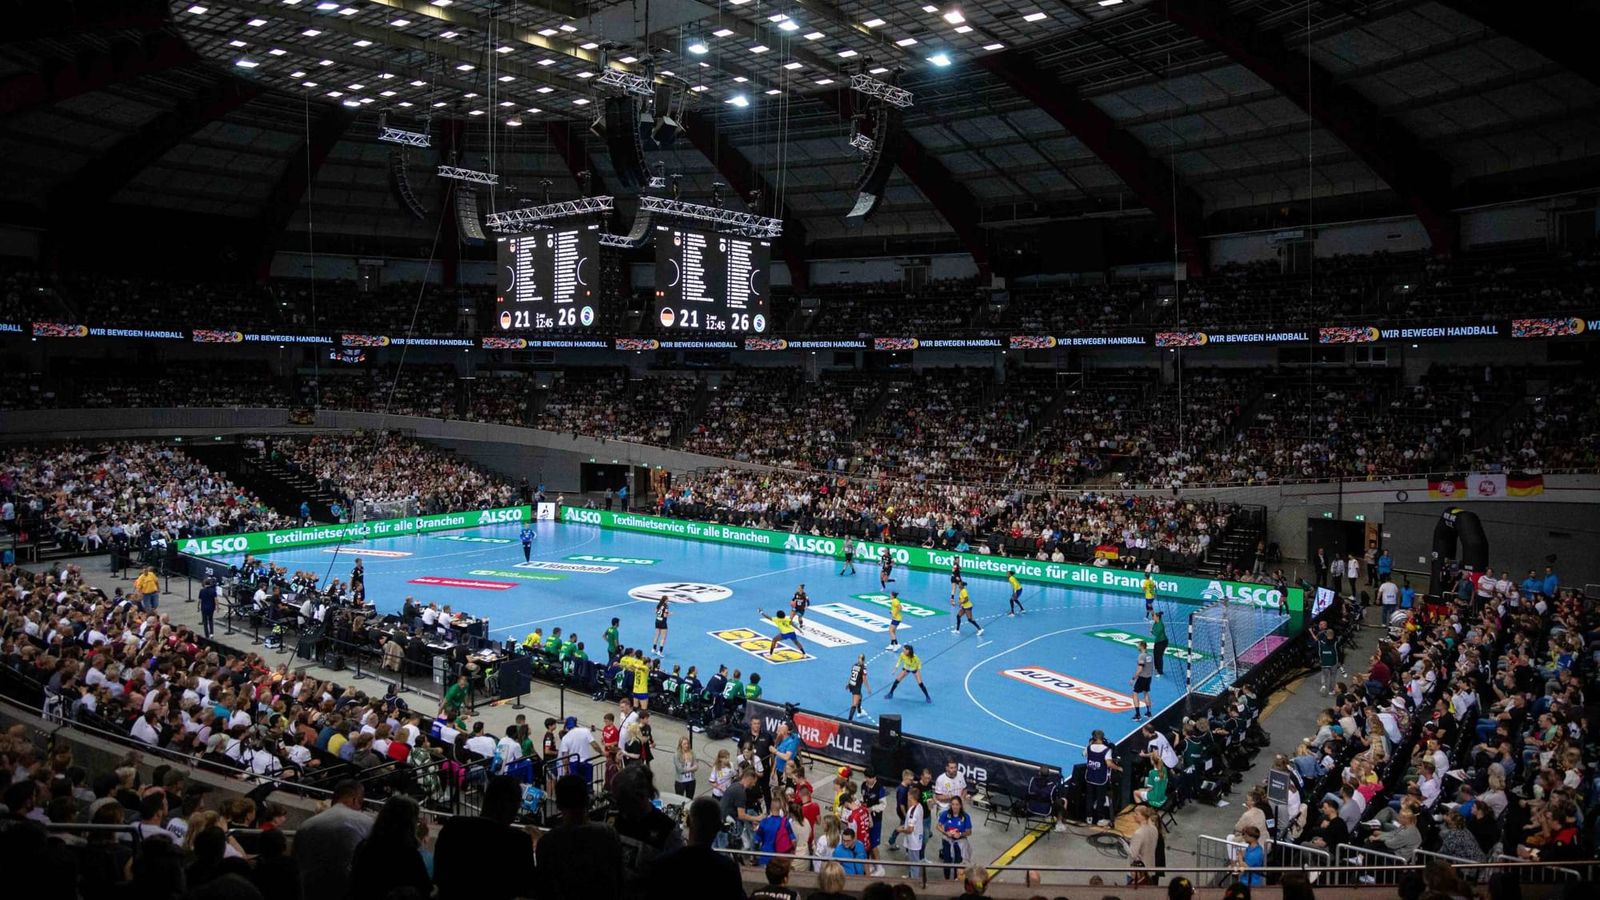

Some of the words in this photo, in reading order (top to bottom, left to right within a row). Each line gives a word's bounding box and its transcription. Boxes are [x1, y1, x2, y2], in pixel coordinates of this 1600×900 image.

[515, 310, 530, 328] 21
[535, 319, 553, 329] 12:45
[558, 308, 576, 326] 26
[680, 309, 699, 328] 21
[706, 320, 726, 331] 12:45
[731, 313, 750, 331] 26
[89, 328, 106, 336] WIR
[107, 328, 144, 338] BEWEGEN
[144, 330, 185, 339] HANDBALL
[244, 334, 260, 342] WIR
[260, 334, 296, 343] BEWEGEN
[296, 335, 334, 343] HANDBALL
[1208, 334, 1225, 343] WIR
[1226, 333, 1265, 343] BEWEGEN
[1265, 331, 1310, 341] HANDBALL
[1380, 329, 1400, 338] WIR
[1400, 327, 1446, 338] BEWEGEN
[1446, 324, 1500, 336] HANDBALL
[390, 337, 405, 345] WIR
[405, 338, 439, 346] BEWEGEN
[439, 339, 475, 347] HANDBALL
[527, 340, 542, 348] WIR
[542, 340, 574, 348] BEWEGEN
[659, 341, 673, 349] WIR
[673, 341, 704, 349] BEWEGEN
[833, 340, 867, 348] HANDBALL
[919, 339, 934, 347] WIR
[934, 339, 966, 347] BEWEGEN
[966, 339, 1002, 347] HANDBALL
[1056, 338, 1072, 346] WIR
[1072, 337, 1107, 346] BEWEGEN
[1107, 336, 1147, 345] HANDBALL
[478, 508, 523, 525] ALSCO
[565, 507, 602, 524] ALSCO
[267, 525, 370, 545] Textilmietservice
[374, 521, 391, 534] für
[394, 518, 413, 531] alle
[416, 514, 465, 529] Branchen
[613, 513, 684, 534] Textilmietservice
[686, 523, 701, 536] für
[703, 526, 720, 538] alle
[722, 525, 769, 544] Branchen
[184, 537, 248, 555] ALSCO
[784, 533, 836, 555] ALSCO
[1046, 566, 1068, 580] für
[1072, 568, 1098, 583] alle
[1202, 580, 1283, 608] ALSCO
[1013, 668, 1133, 709] AUTOHERO
[826, 732, 866, 755] ALLE.
